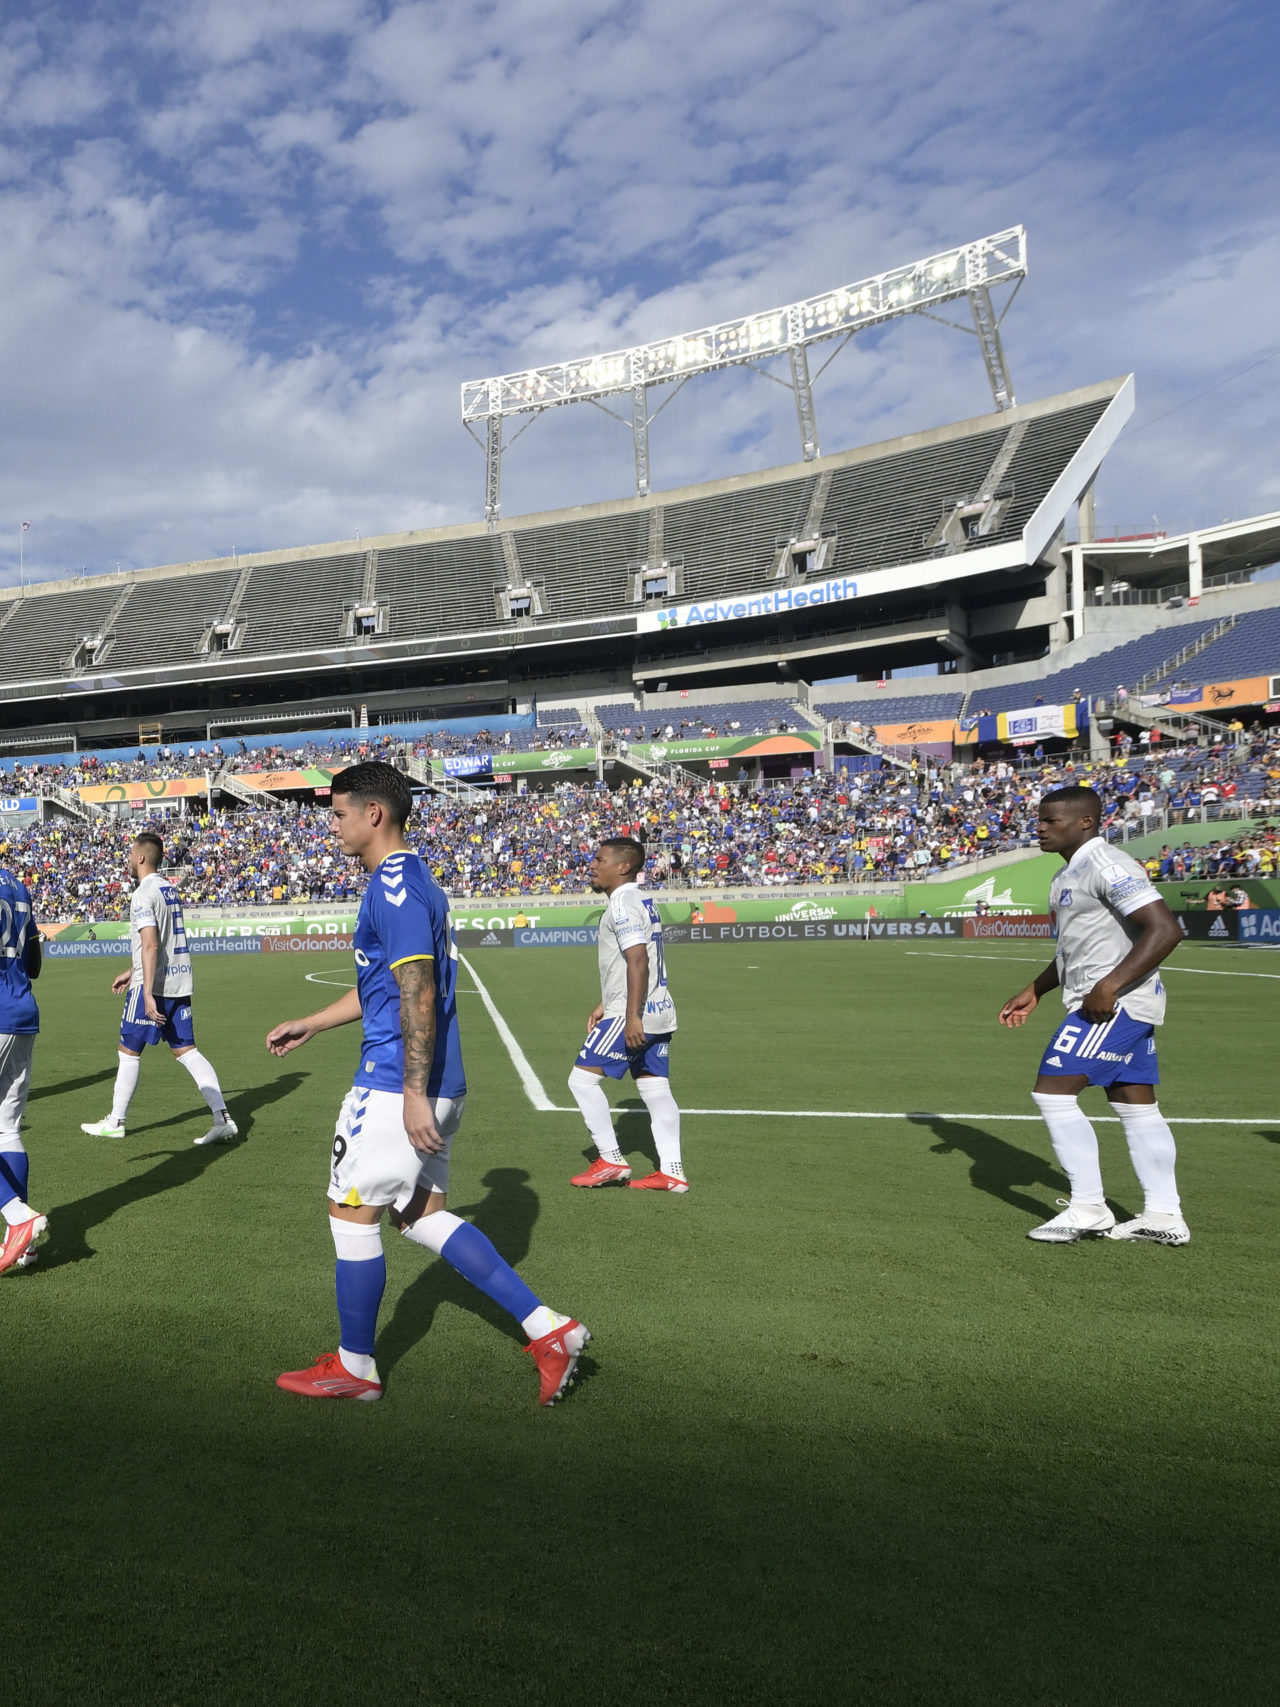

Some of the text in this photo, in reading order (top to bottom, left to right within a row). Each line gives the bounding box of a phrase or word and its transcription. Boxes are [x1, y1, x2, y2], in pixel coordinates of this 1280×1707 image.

[685, 579, 858, 624] AdventHealth
[444, 756, 489, 770] EDWAR
[775, 907, 838, 922] UNIVERSAL
[521, 931, 586, 944] CAMPING
[691, 922, 955, 939] EL FÚTBOL ES UNIVERSAL
[49, 943, 100, 955] CAMPING
[188, 937, 261, 952] ventHealth
[1053, 1025, 1082, 1053] 6
